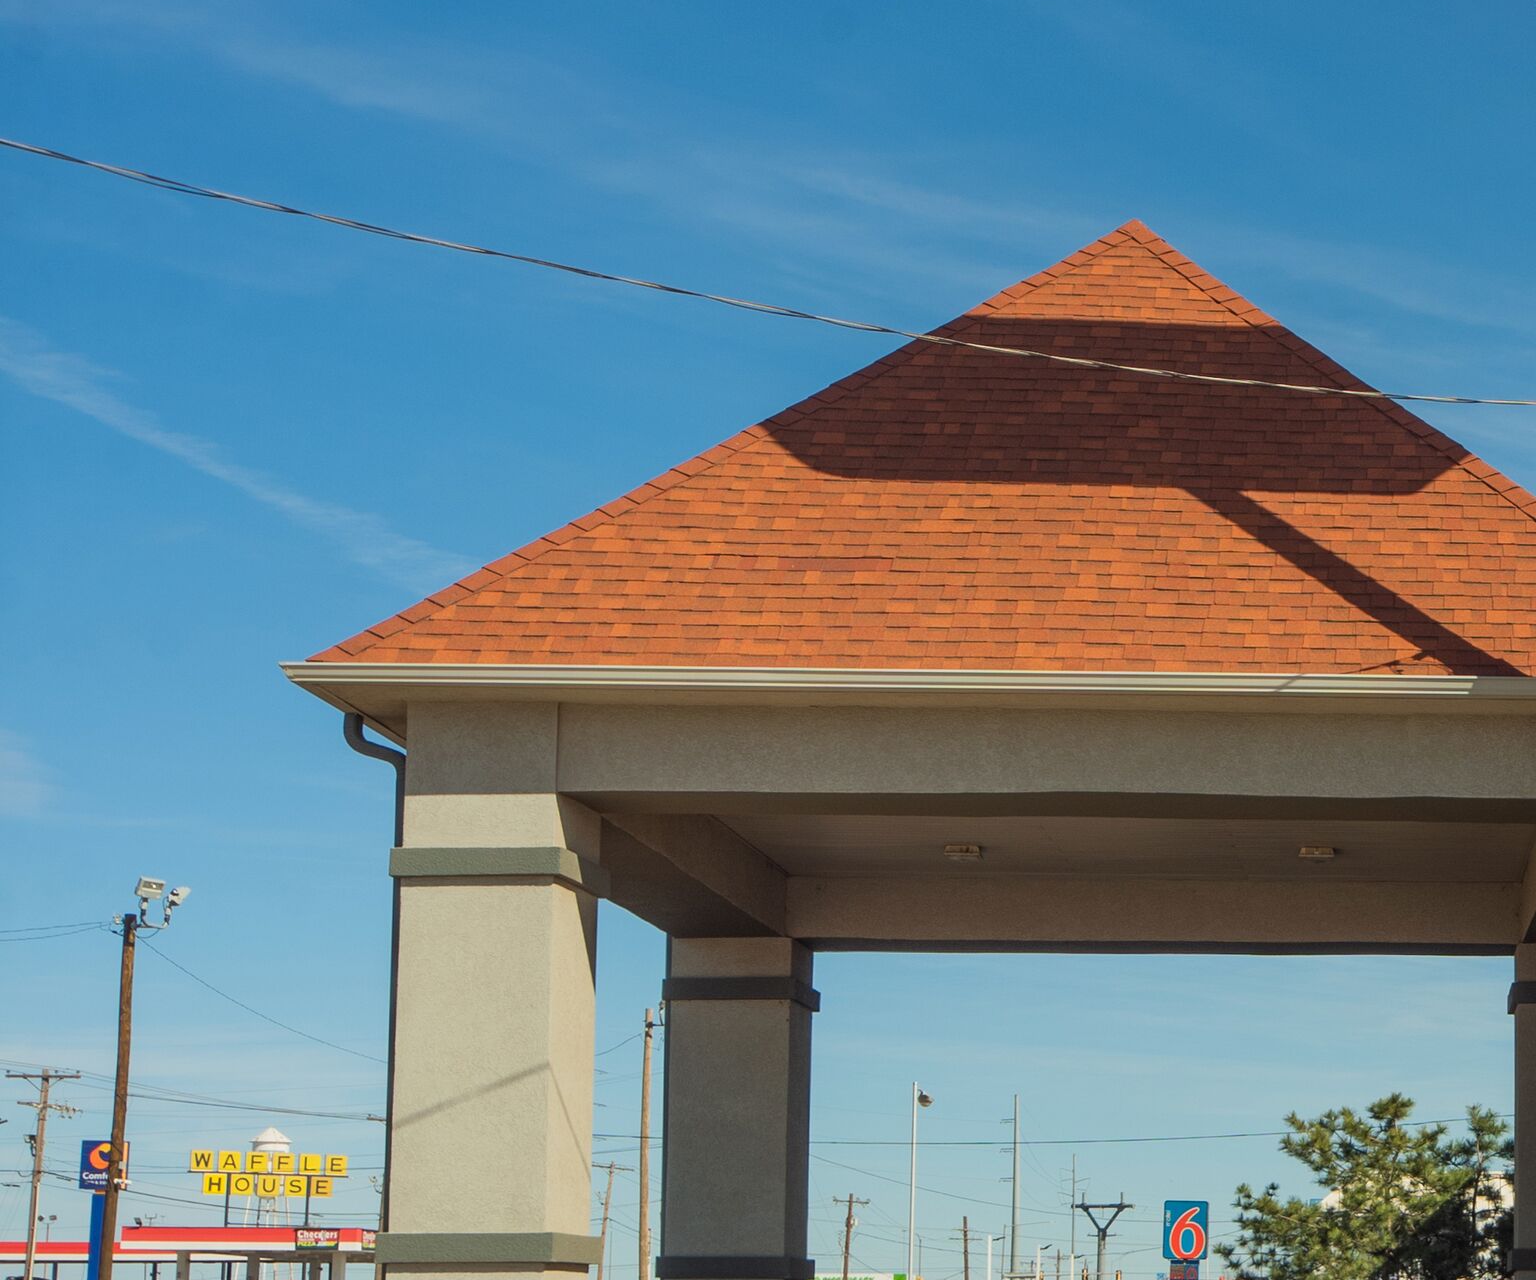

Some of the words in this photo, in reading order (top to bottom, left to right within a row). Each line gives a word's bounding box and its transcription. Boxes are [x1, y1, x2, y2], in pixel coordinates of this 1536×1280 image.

[194, 1152, 343, 1172] WAFFLE
[208, 1176, 329, 1195] HOUSE
[1169, 1207, 1206, 1260] 6
